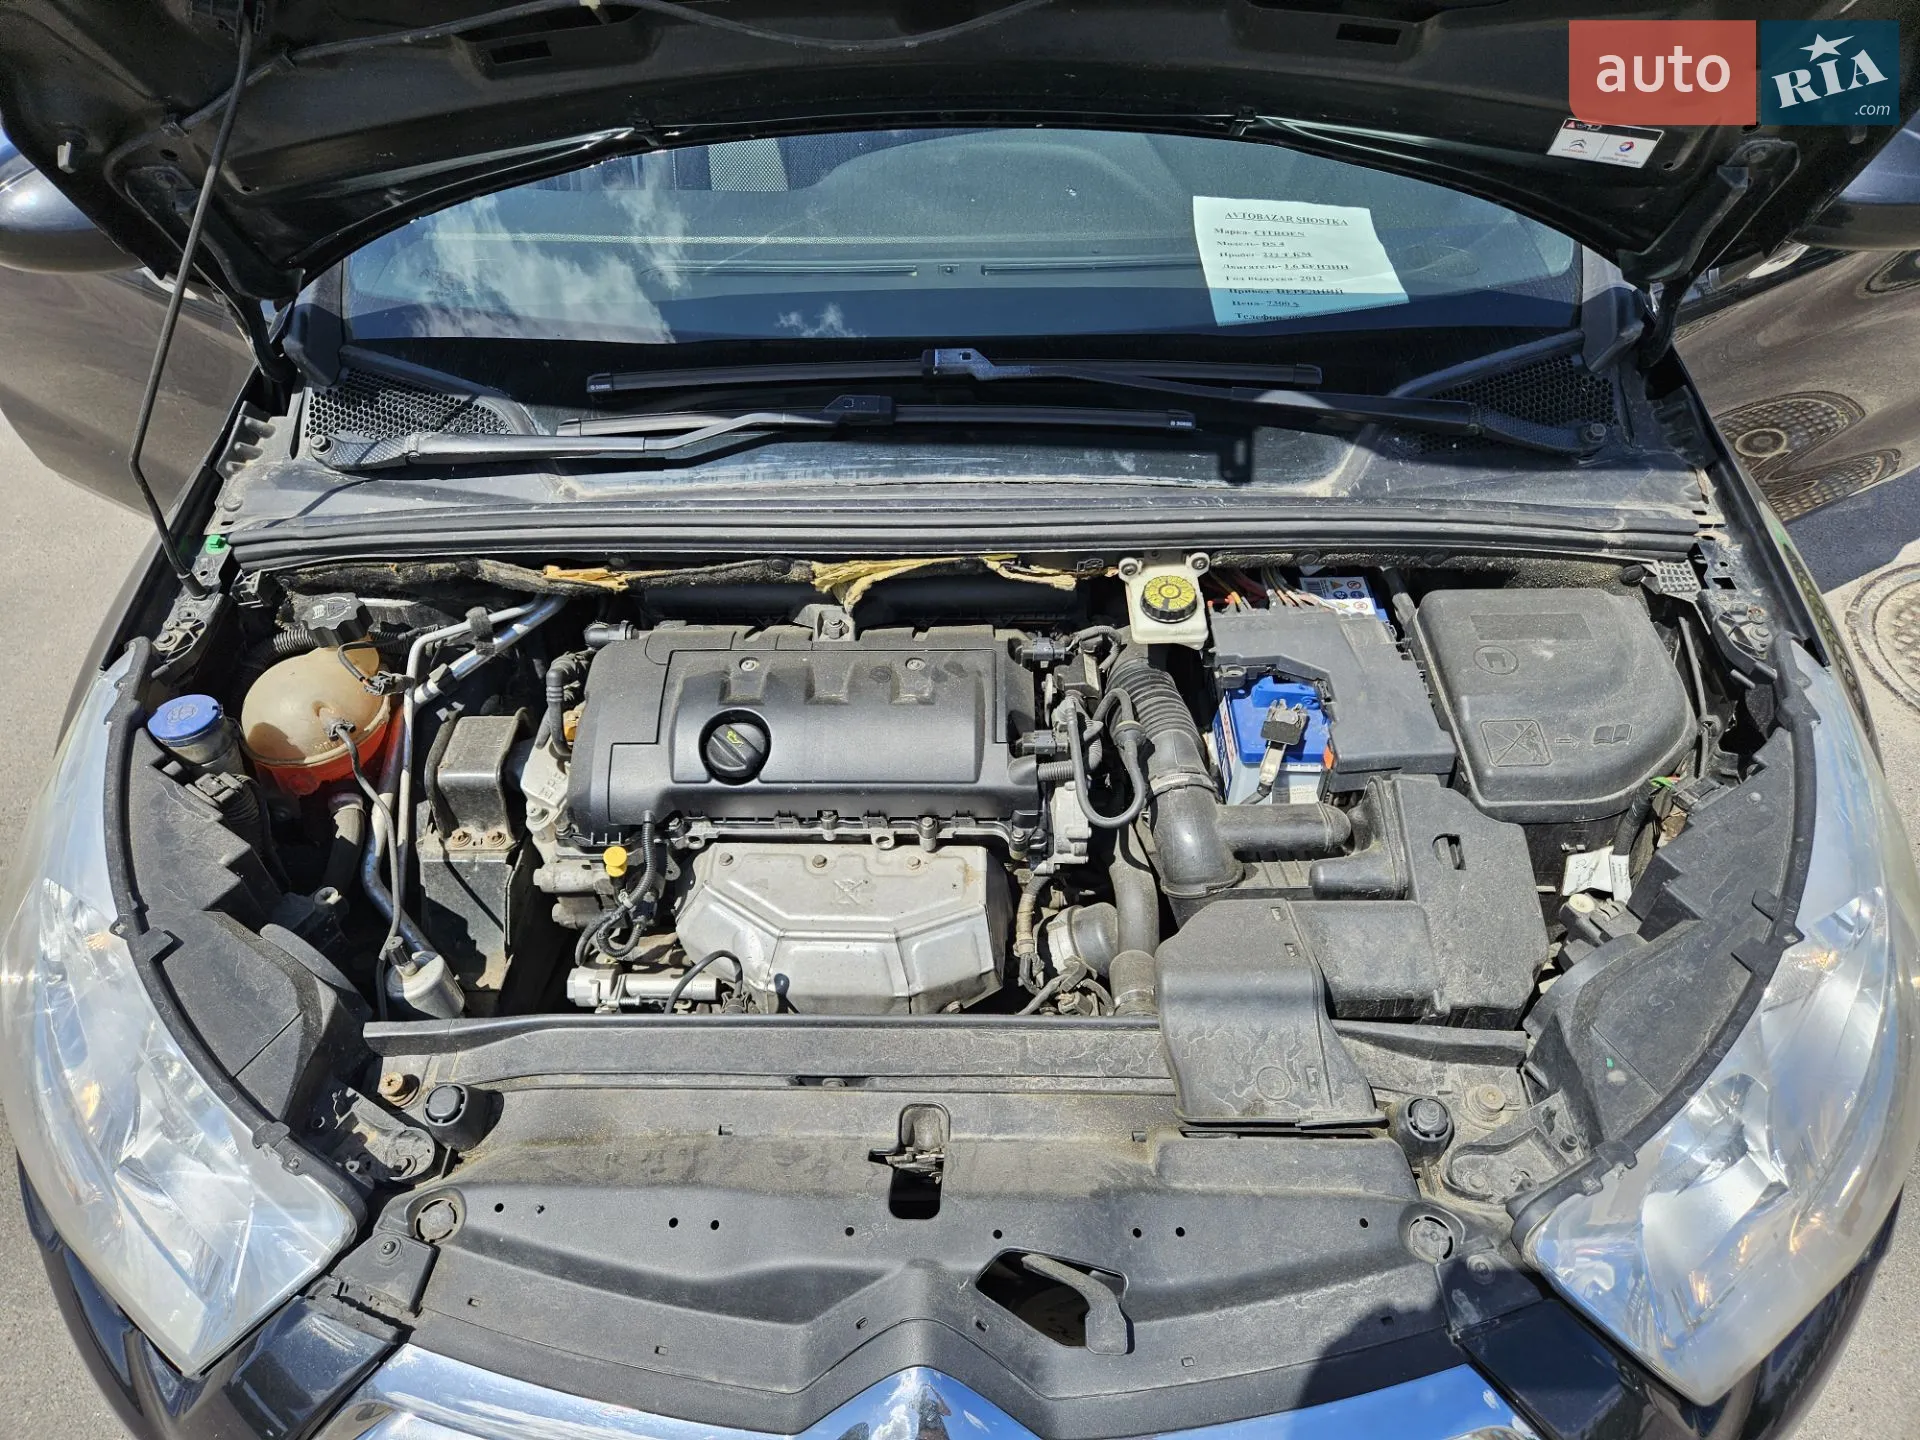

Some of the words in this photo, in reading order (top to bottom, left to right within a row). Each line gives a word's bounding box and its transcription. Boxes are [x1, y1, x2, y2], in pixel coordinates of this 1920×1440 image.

[1225, 212, 1294, 223] AVTOBAZAR
[1296, 215, 1348, 226] SHOSTKA
[1254, 229, 1305, 237] CITROEN
